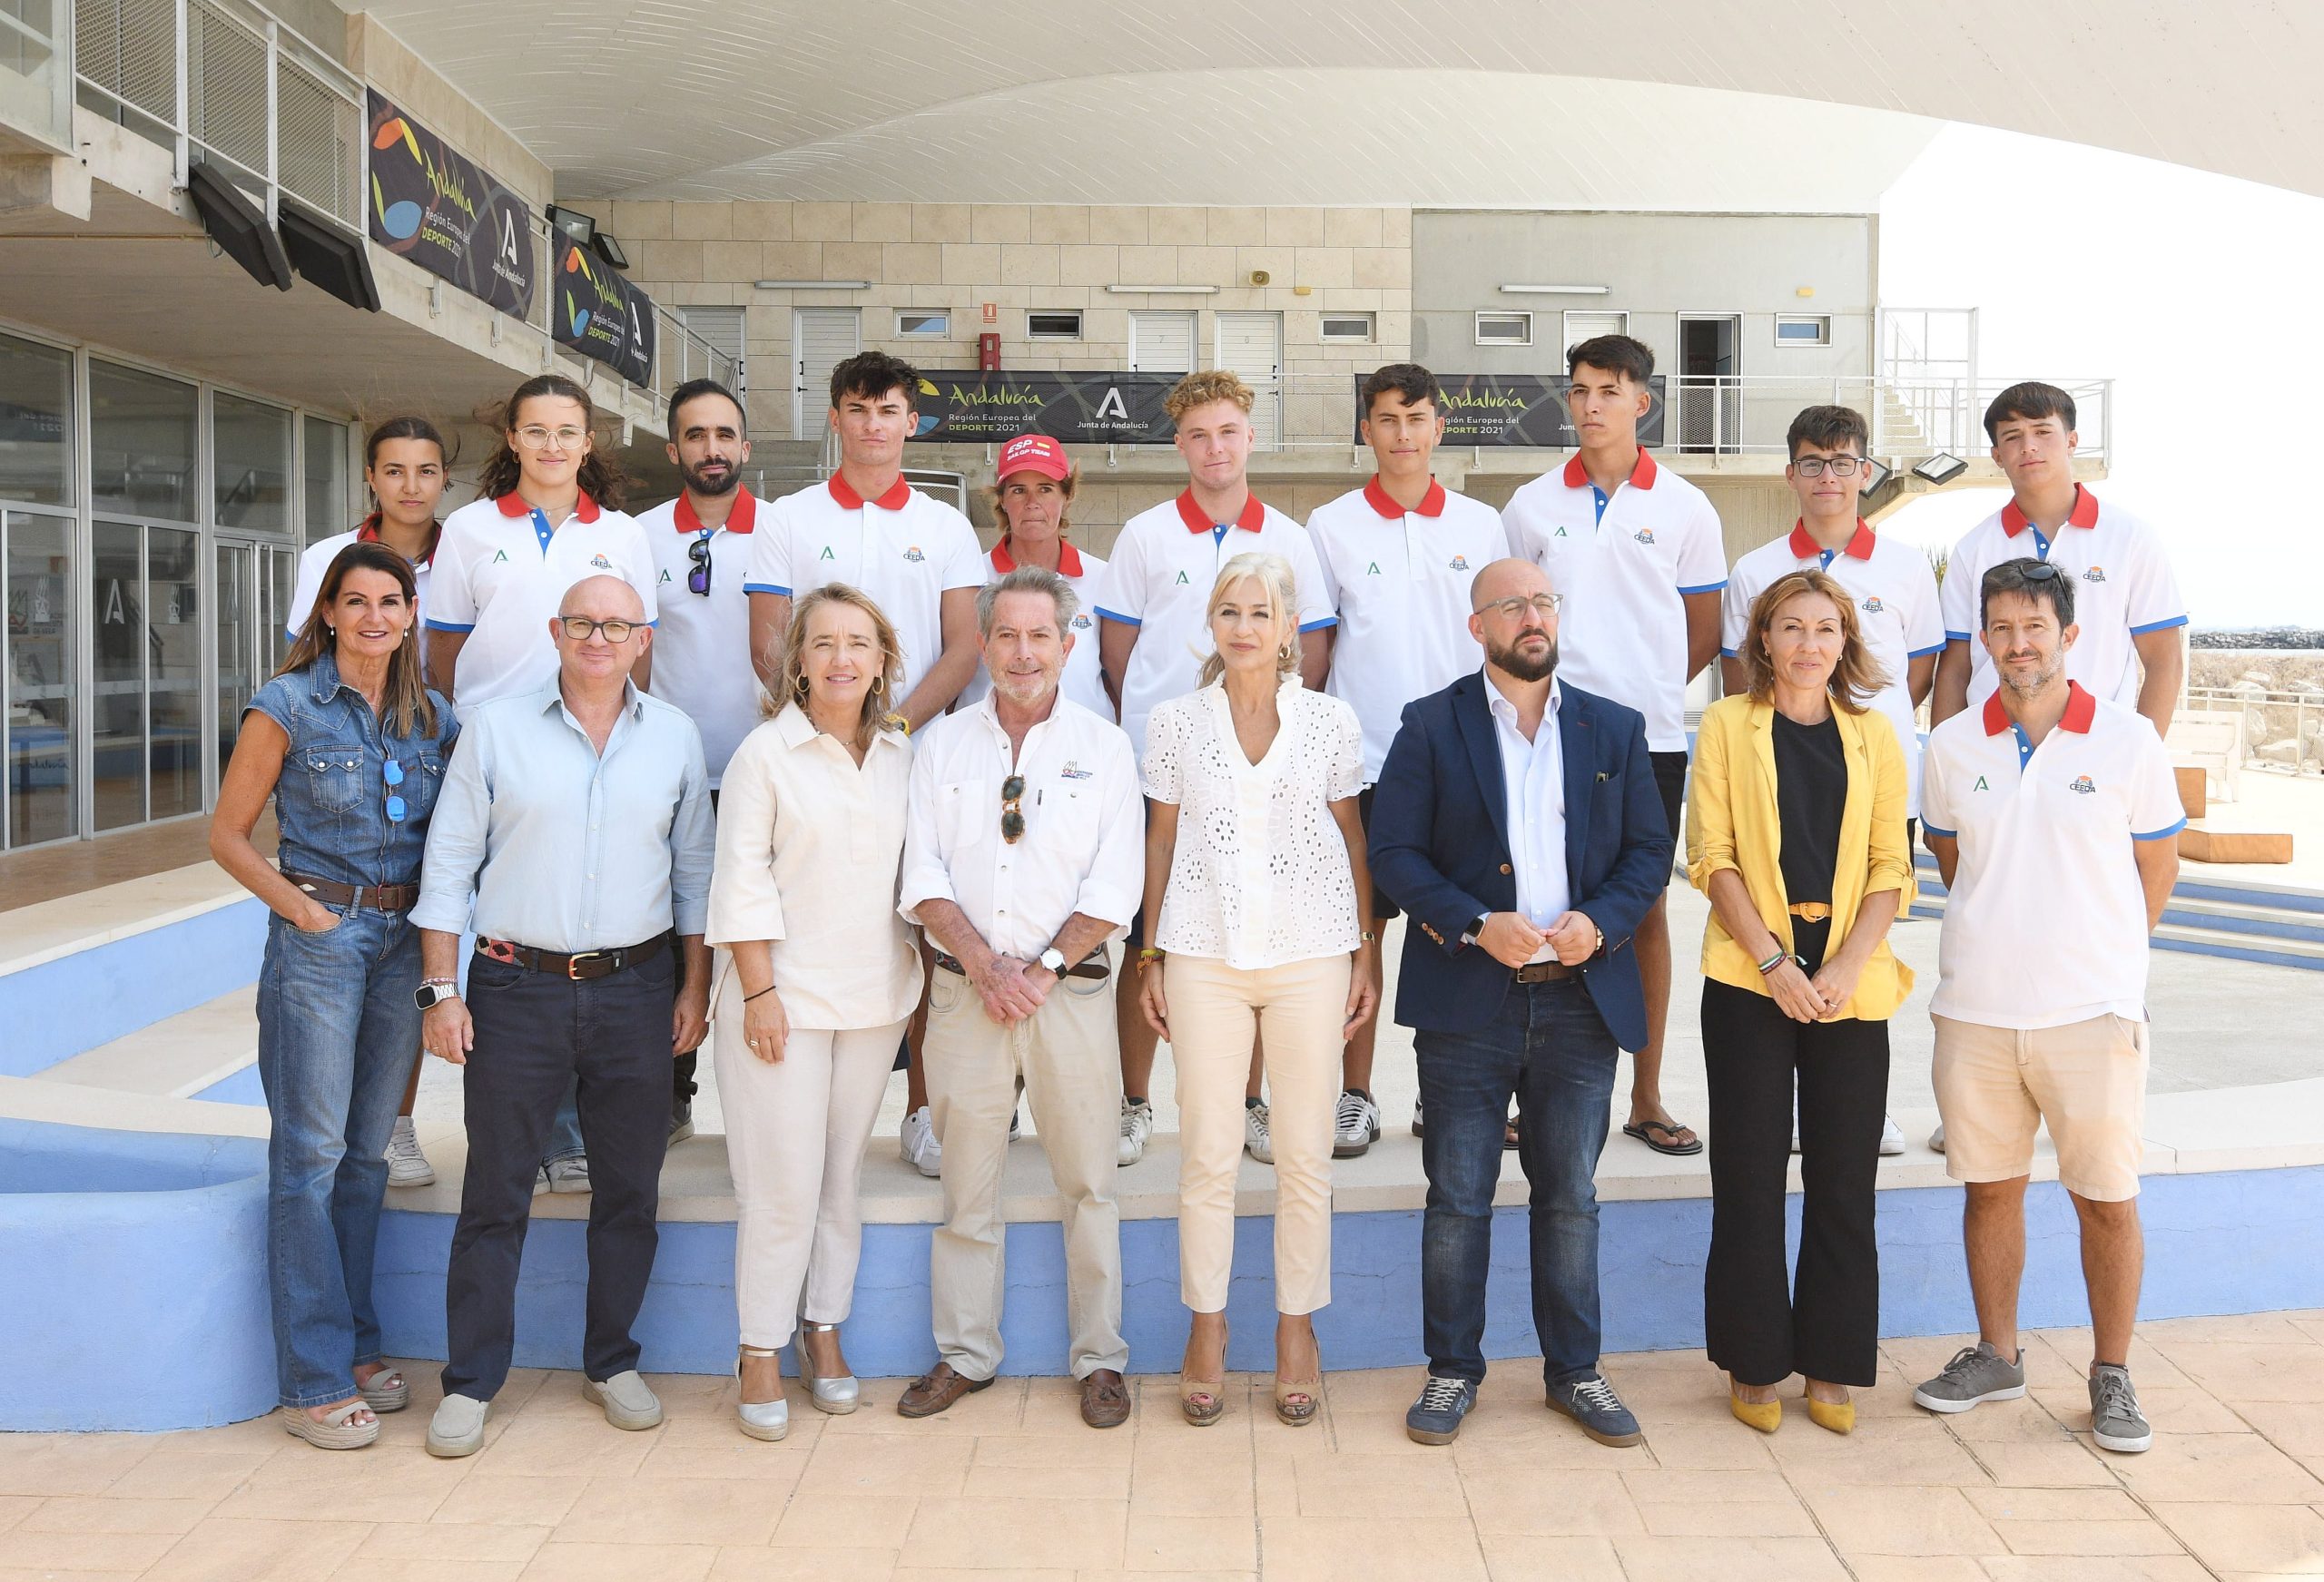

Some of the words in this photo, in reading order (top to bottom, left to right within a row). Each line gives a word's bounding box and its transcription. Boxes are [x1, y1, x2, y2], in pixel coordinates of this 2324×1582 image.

[425, 206, 447, 227] Región
[421, 226, 451, 251] DEPORTE
[451, 241, 461, 258] 2021
[588, 327, 611, 343] DEPORTE
[947, 384, 1047, 407] Andalucía
[949, 413, 980, 423] Región
[982, 414, 1019, 423] Europea
[1022, 413, 1037, 421] del
[1444, 416, 1464, 426] gión
[1467, 417, 1503, 425] Europea
[1111, 421, 1148, 429] Andalucía
[1007, 439, 1033, 455] ESP
[902, 553, 925, 561] CEEDA
[2083, 573, 2106, 582] CEEDA
[1862, 604, 1884, 612] CEEDA
[2070, 783, 2096, 793] CEEDA
